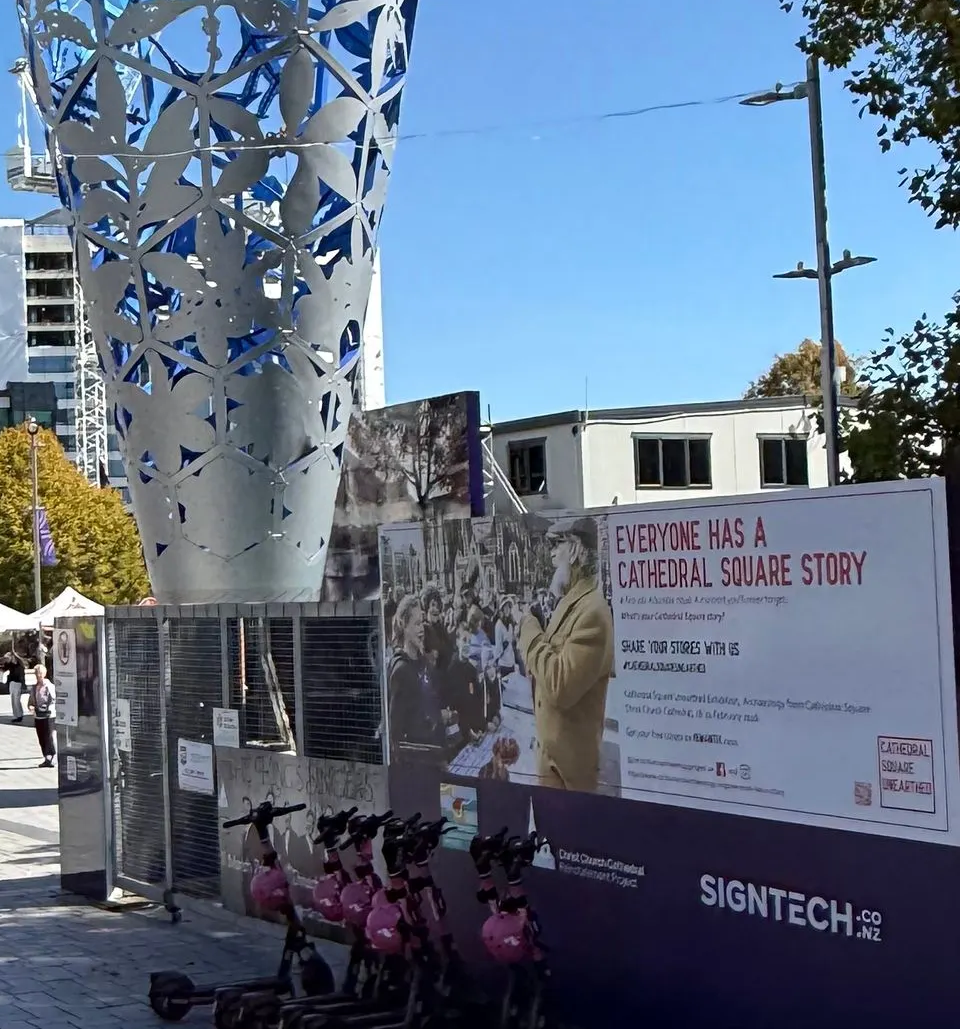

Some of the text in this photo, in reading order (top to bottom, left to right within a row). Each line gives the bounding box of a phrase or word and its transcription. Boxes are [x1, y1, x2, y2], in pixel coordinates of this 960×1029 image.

[616, 516, 767, 554] EVERYONE HAS A
[618, 551, 867, 589] CATHEDRAL SQUARE STORY
[880, 740, 930, 757] CATHEDRAL
[882, 759, 916, 775] SQUARE
[700, 873, 882, 937] SIGNTECH .CO
[856, 926, 882, 942] .NZ
